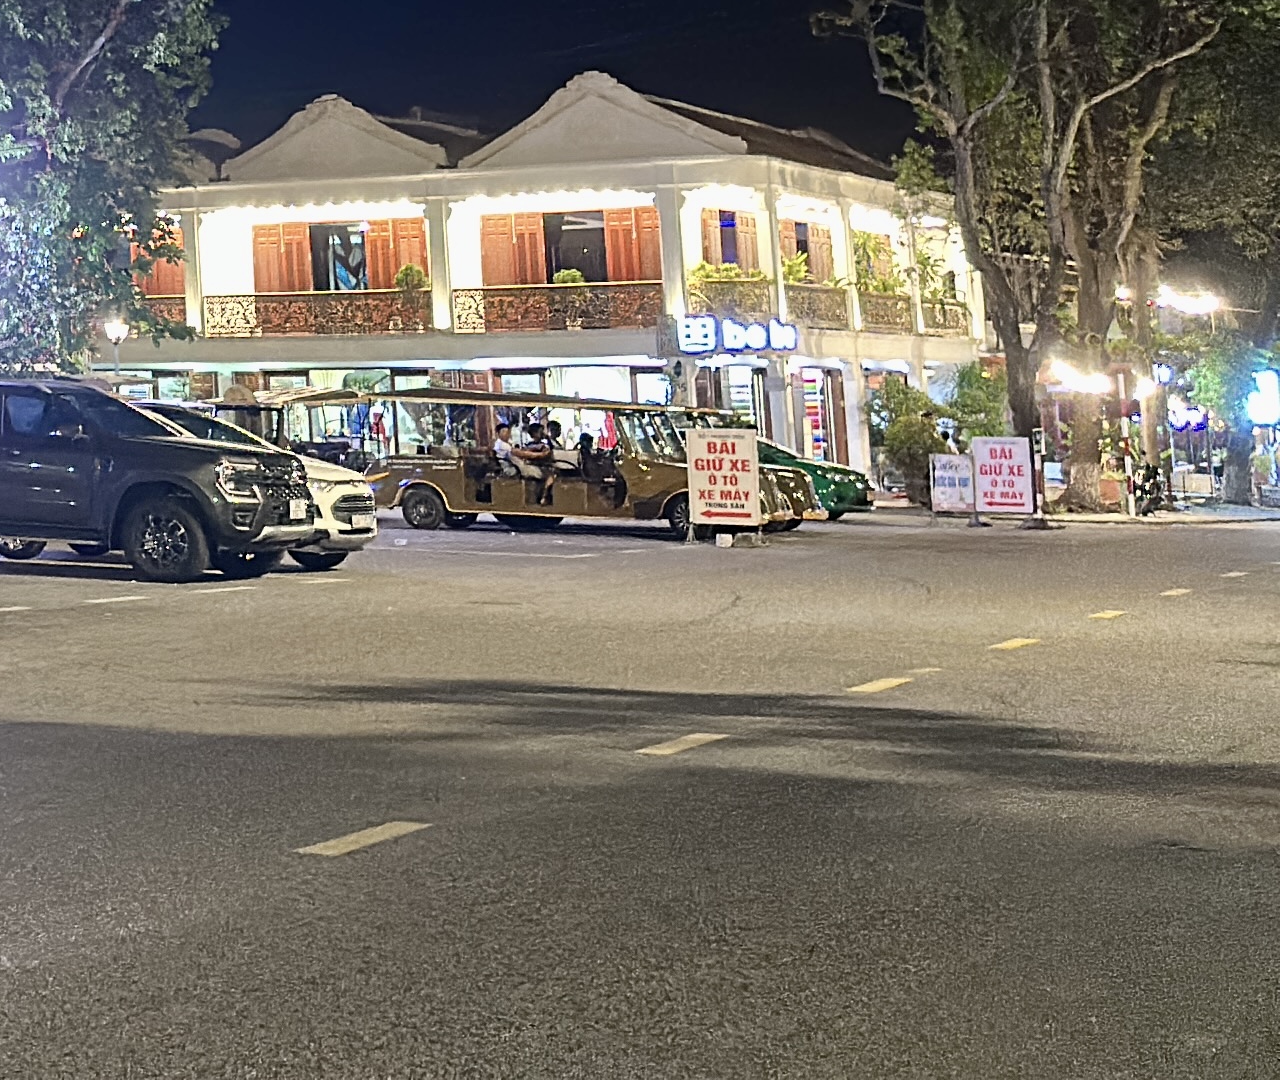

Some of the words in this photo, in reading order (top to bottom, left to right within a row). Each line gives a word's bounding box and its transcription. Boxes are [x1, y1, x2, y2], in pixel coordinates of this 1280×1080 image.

[729, 459, 751, 472] XE
[1007, 464, 1024, 476] XE
[698, 489, 715, 500] XE
[983, 491, 995, 499] XE
